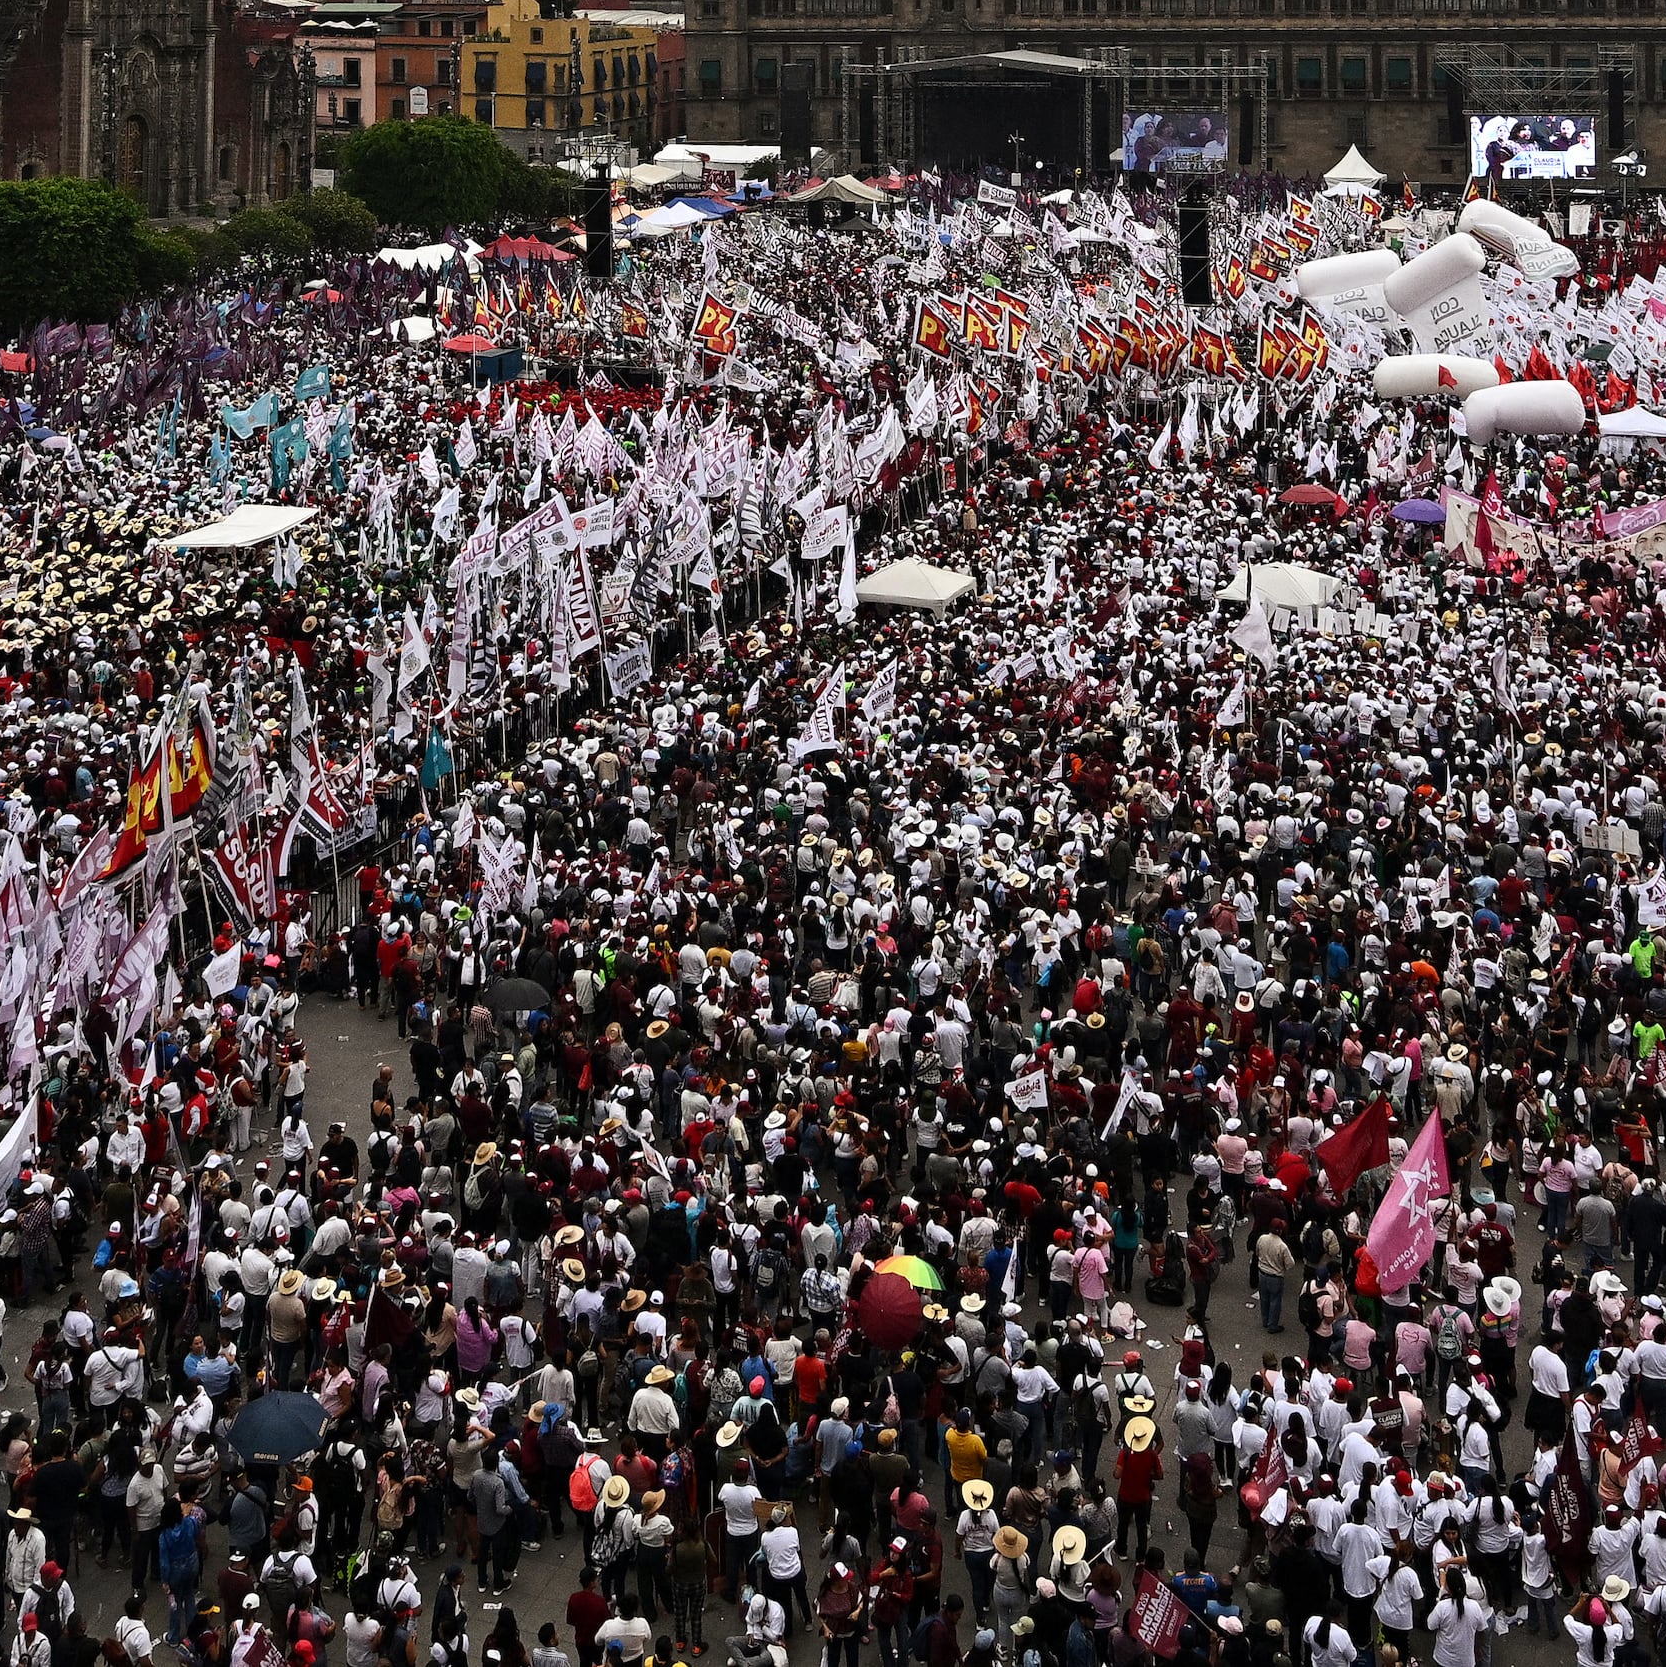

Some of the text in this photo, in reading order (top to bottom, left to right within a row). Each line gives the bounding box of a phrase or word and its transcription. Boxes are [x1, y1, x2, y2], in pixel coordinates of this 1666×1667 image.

[1292, 203, 1310, 220] PT
[1228, 268, 1245, 296] PT
[698, 306, 731, 335] PT
[611, 611, 638, 622] more
[253, 1452, 280, 1462] morena
[1180, 1577, 1207, 1587] TECATE
